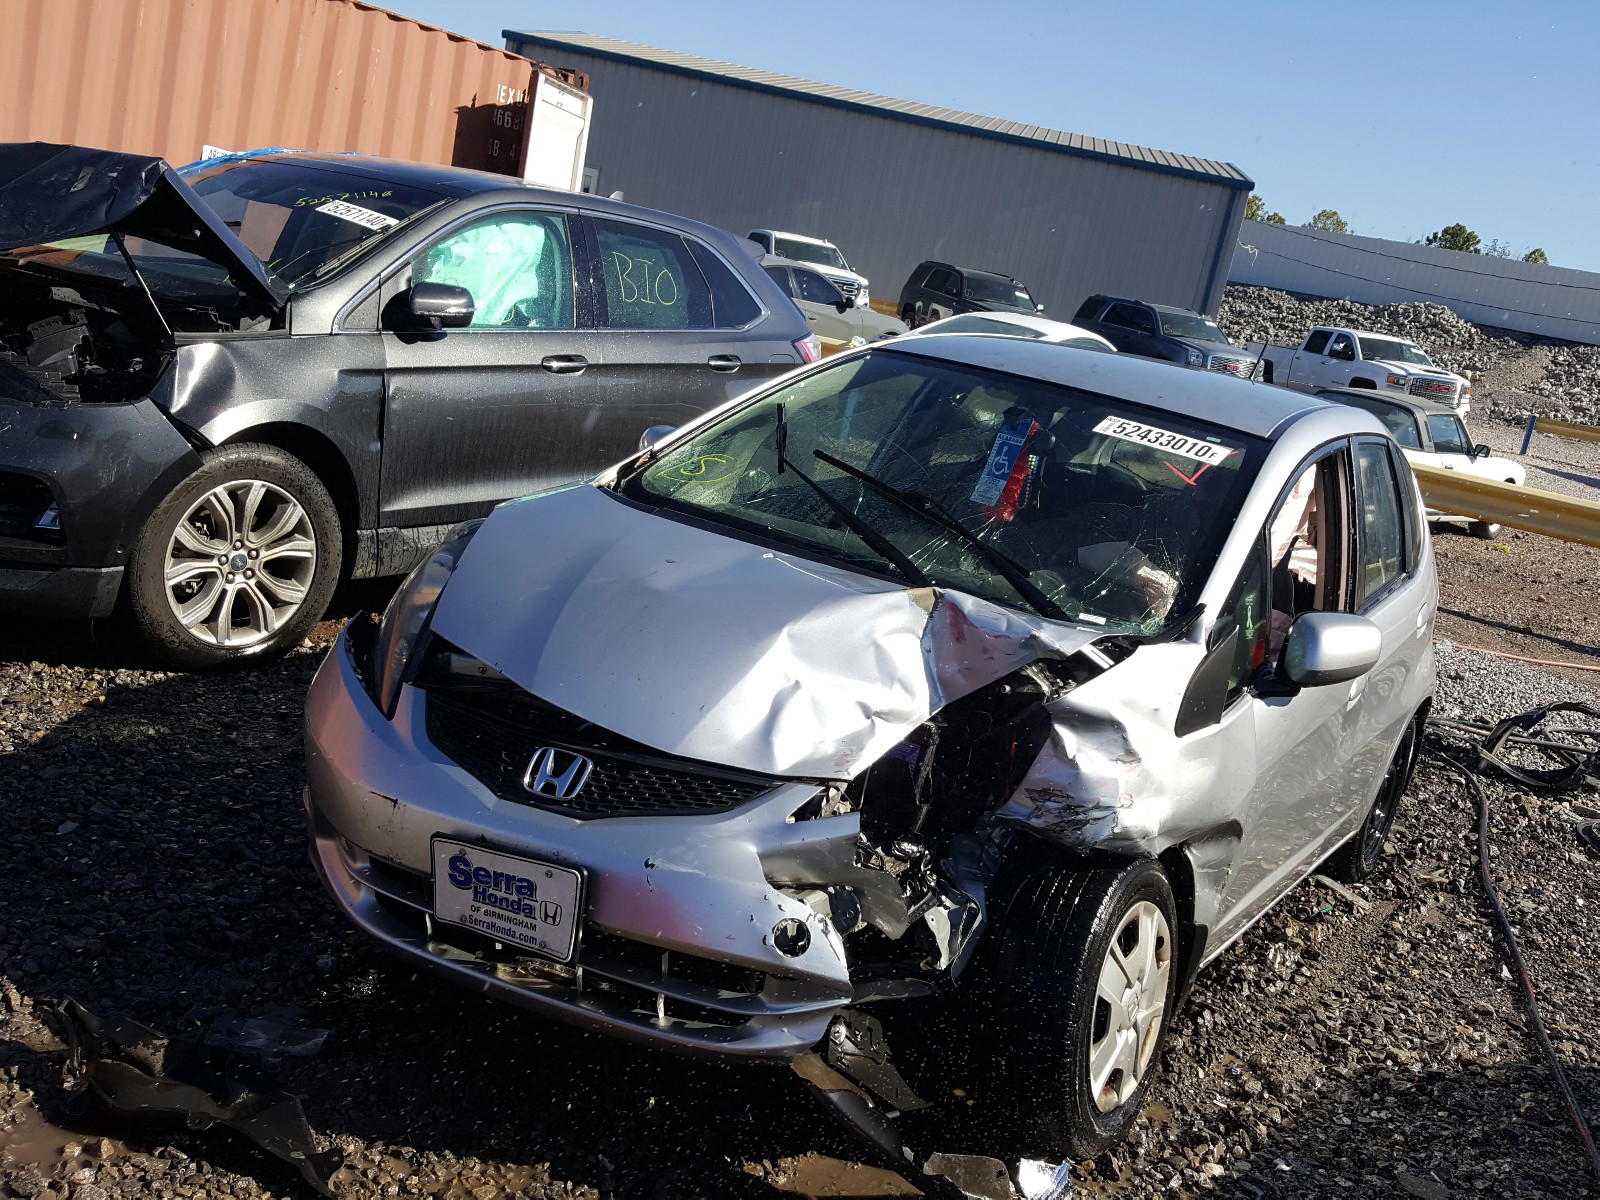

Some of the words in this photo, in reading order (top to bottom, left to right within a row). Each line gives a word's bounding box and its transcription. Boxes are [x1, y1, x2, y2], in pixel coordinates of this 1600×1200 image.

[612, 251, 677, 305] BIO
[1112, 421, 1209, 458] 52433010
[447, 855, 538, 903] Serra
[470, 904, 482, 914] OF
[483, 907, 537, 932] BIRMINGHAM
[472, 884, 537, 920] Honda
[468, 914, 538, 946] SerraHonda.com
